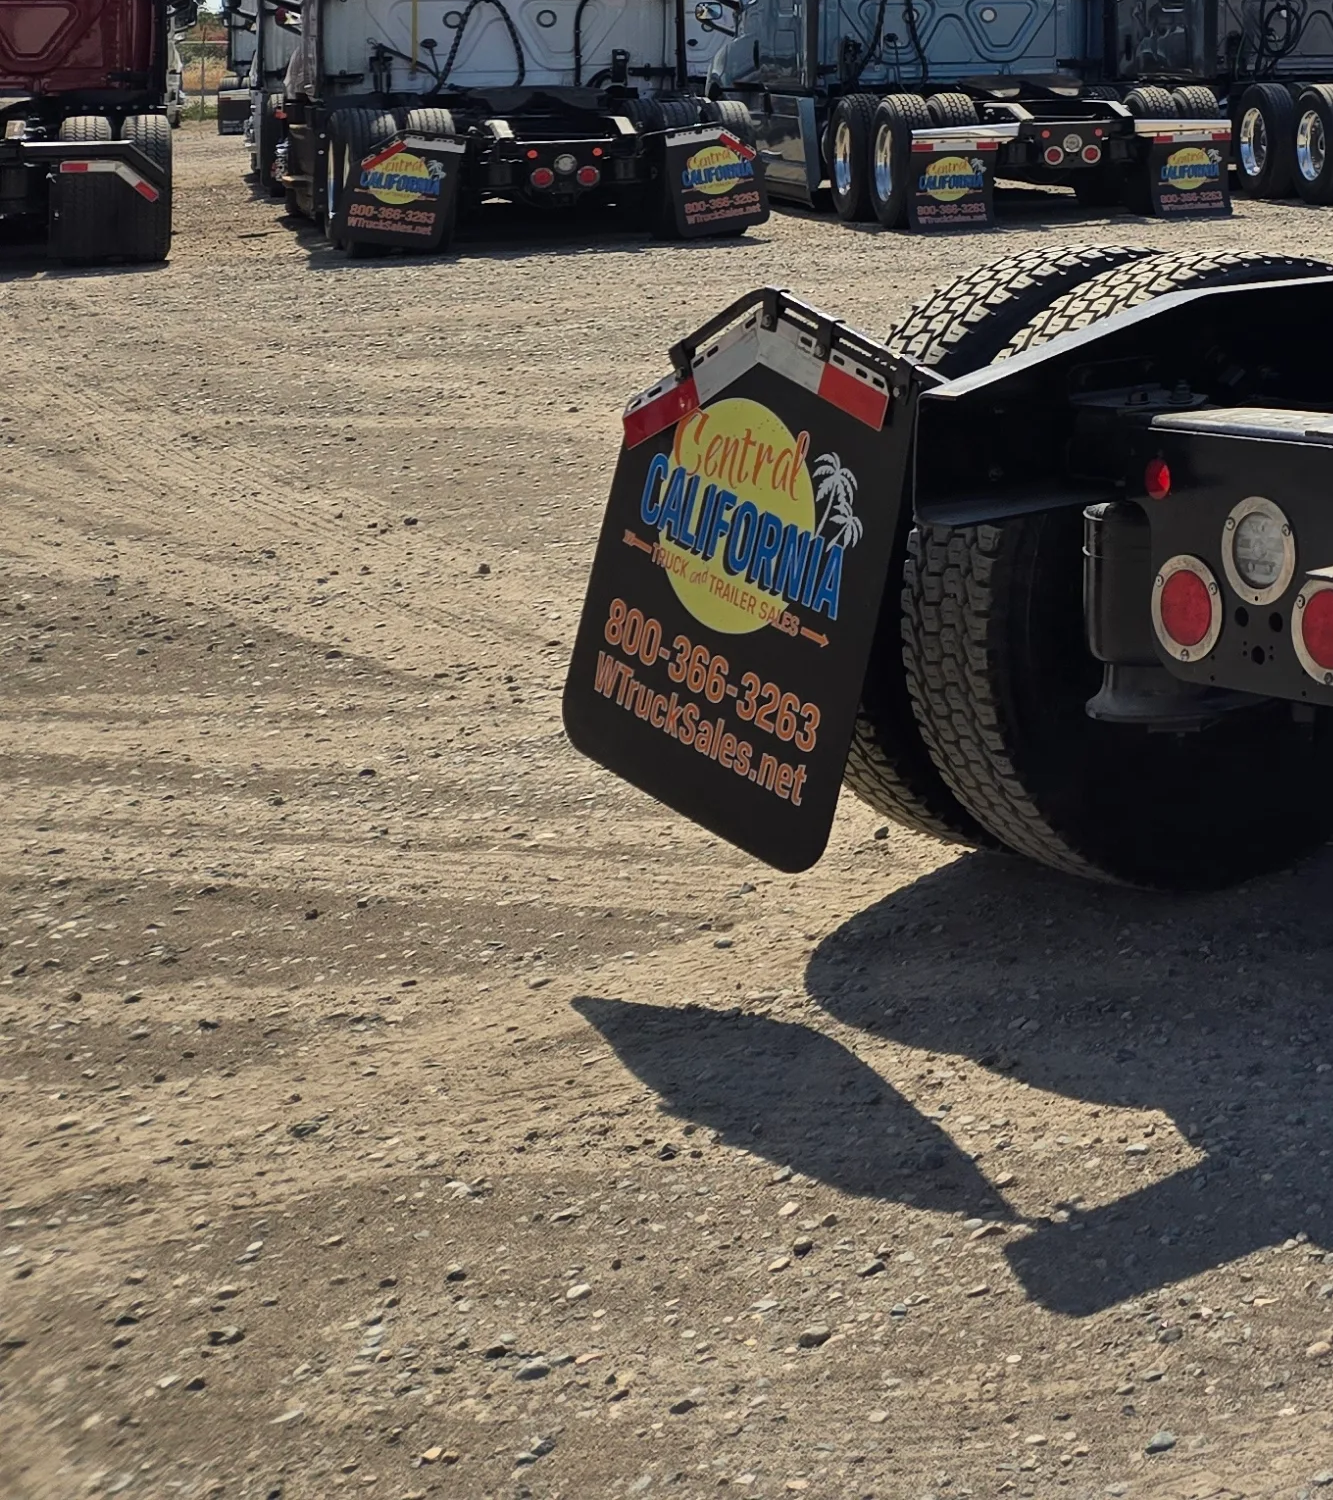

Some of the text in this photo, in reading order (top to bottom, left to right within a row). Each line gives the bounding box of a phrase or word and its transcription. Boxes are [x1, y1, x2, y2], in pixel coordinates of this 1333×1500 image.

[360, 169, 441, 197] CALIFORNIA
[681, 160, 755, 188] CALIFORNIA
[919, 171, 984, 191] CALIFORNIA
[347, 216, 433, 236] WTruckSales.net
[349, 203, 436, 224] 800-366-3263
[673, 408, 811, 501] Central
[640, 452, 845, 621] CALIFORNIA
[651, 542, 800, 637] TRUCK and TRAILER SALES
[604, 597, 821, 752] 800-366-3263
[593, 650, 808, 807] WTruckSales.net
